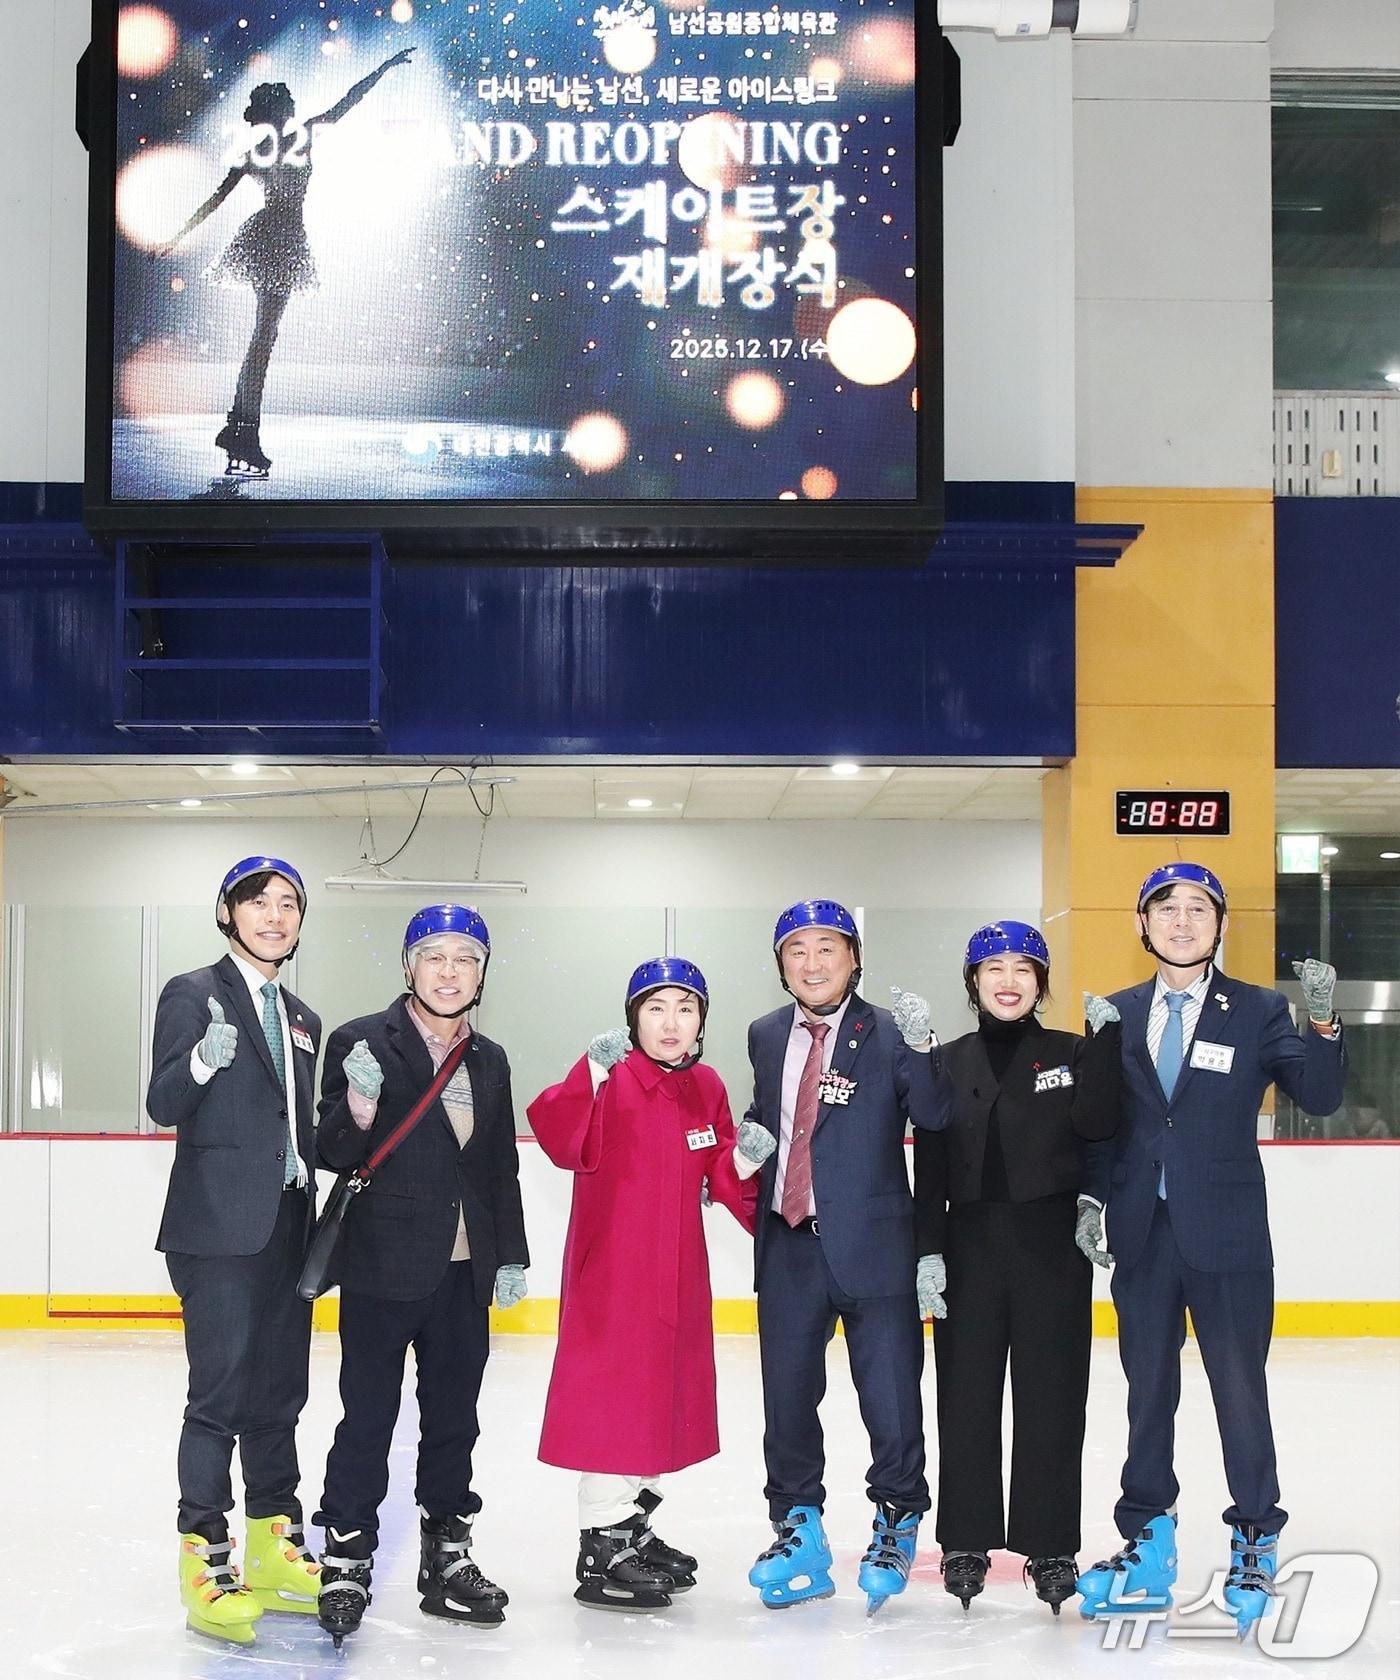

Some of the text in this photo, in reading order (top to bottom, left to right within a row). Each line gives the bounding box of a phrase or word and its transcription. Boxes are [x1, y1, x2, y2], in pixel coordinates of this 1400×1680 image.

[668, 12, 838, 36] 남선공원종합체육관
[477, 76, 838, 106] 다시 만나는 남선, 새로운 아이스링크
[545, 121, 841, 166] REOPNING
[551, 180, 846, 246] 스케이트장
[609, 244, 838, 309] 재개장식
[670, 338, 830, 361] 2025.12.17.(수
